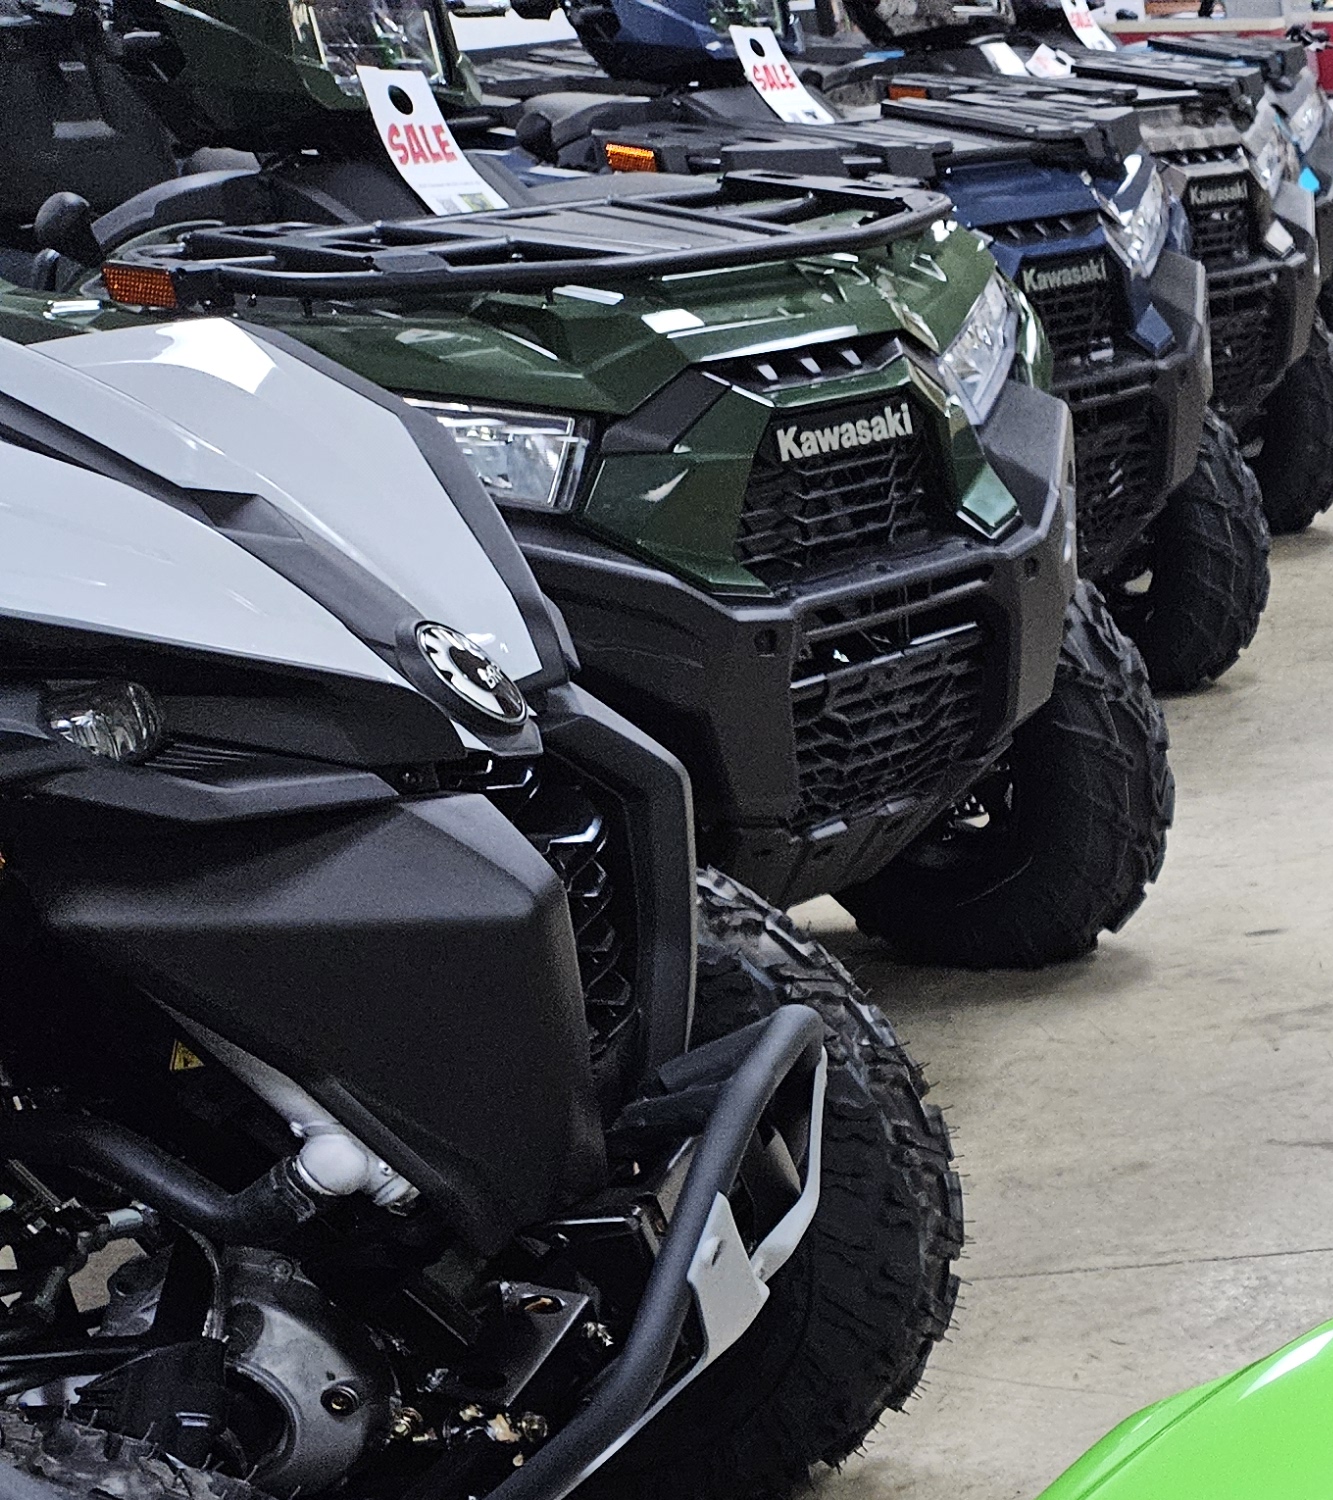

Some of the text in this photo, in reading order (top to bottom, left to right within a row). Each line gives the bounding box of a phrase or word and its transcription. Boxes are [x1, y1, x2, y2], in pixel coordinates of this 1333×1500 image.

[753, 64, 797, 91] SALE
[387, 123, 457, 165] SALE
[1022, 257, 1107, 293] Kawasaki
[776, 402, 914, 462] Kawasaki
